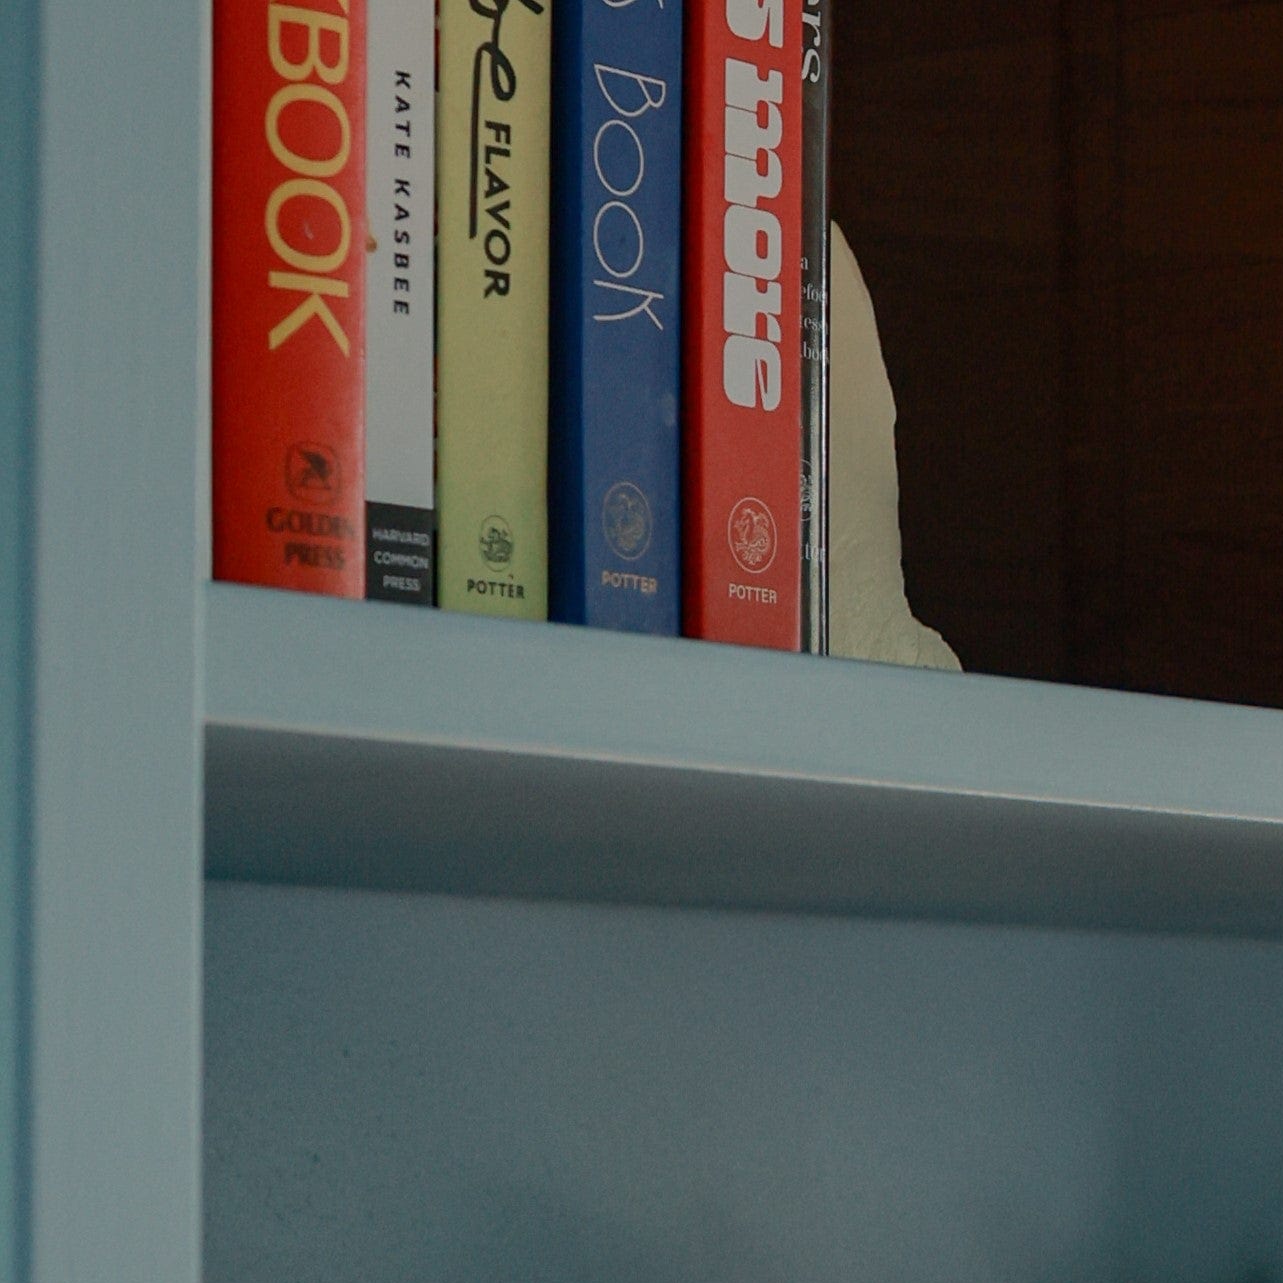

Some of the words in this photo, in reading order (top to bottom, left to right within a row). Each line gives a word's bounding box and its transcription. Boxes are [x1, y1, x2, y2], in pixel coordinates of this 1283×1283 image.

[801, 0, 821, 84] rs
[394, 70, 412, 159] KATE
[264, 0, 352, 358] BOOK
[484, 120, 512, 299] FLAVOR
[393, 178, 411, 315] KASBEE
[723, 57, 783, 412] more
[371, 527, 431, 547] HARVARD
[284, 543, 345, 571] PRESS
[373, 550, 430, 570] COMMON
[382, 574, 422, 592] PRESS
[466, 578, 526, 599] POTTER
[601, 570, 658, 594] POTTER
[728, 583, 778, 604] POTTER
